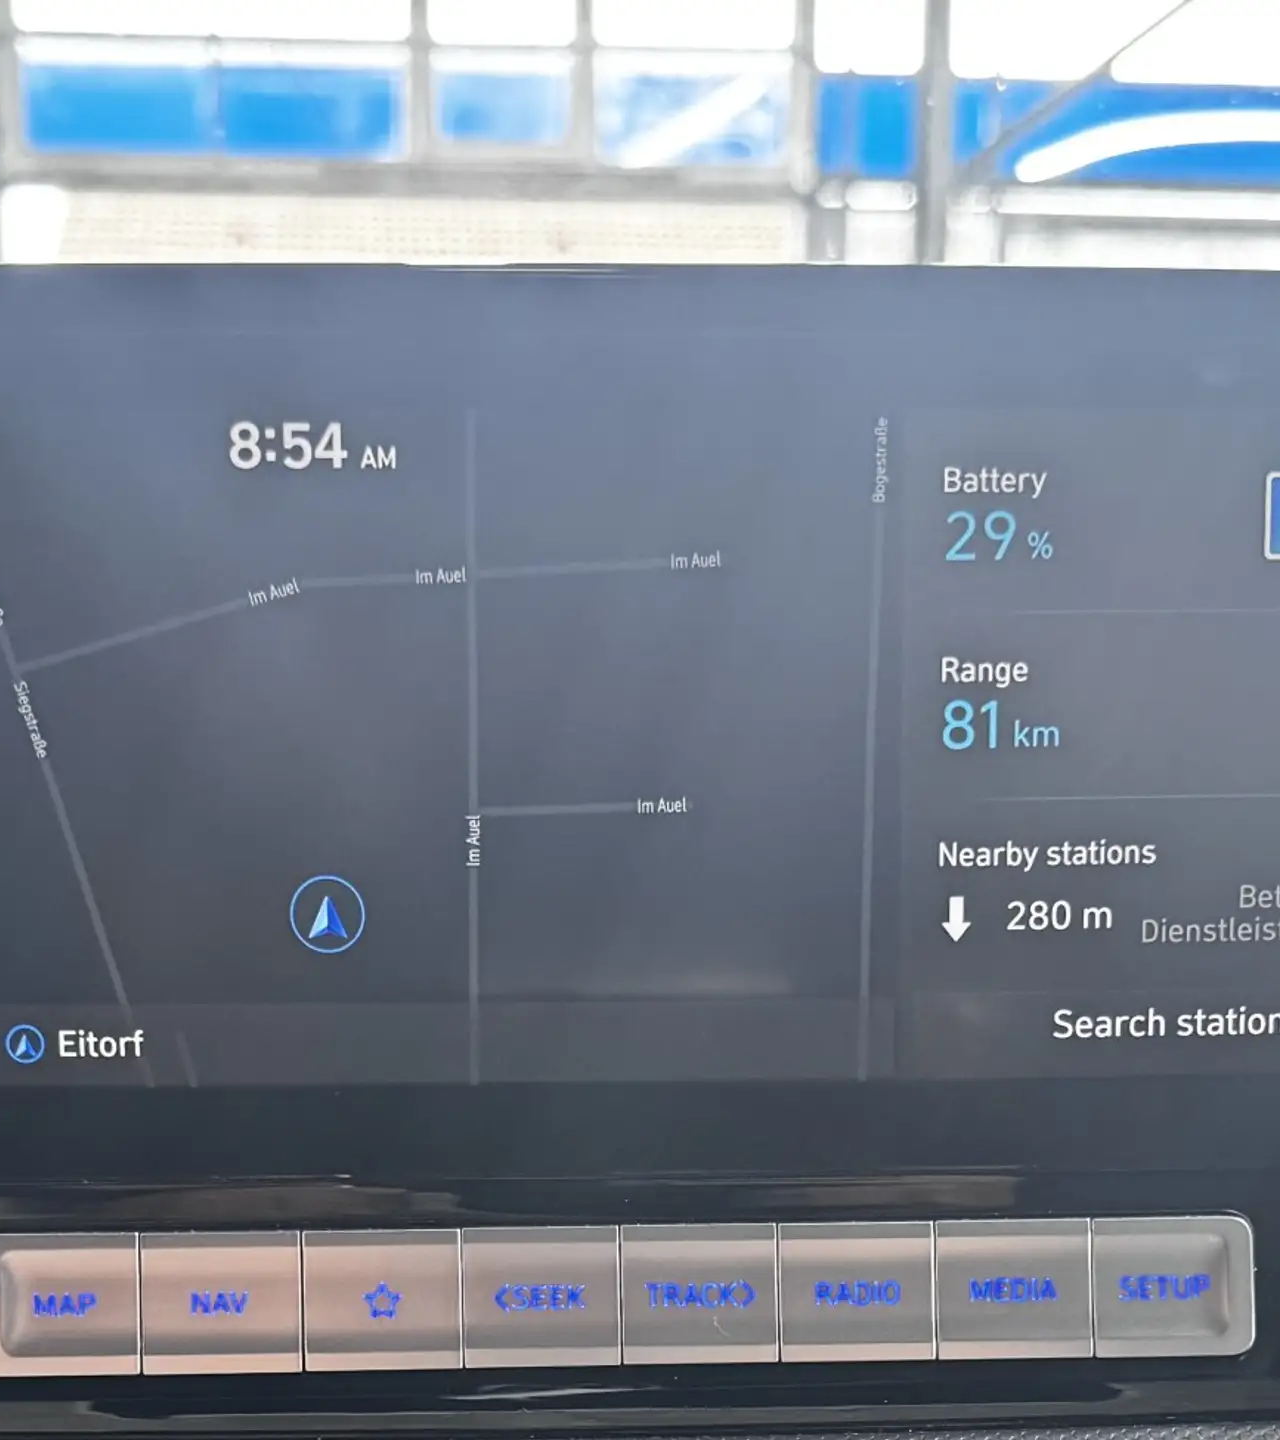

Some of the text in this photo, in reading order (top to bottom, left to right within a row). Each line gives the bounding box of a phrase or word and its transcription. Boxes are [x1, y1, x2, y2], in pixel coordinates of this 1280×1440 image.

[229, 421, 397, 470] 8:54 AM
[943, 466, 1048, 499] Battery
[945, 510, 1054, 561] 29 %
[415, 566, 467, 585] Im Auel
[670, 551, 721, 570] Im Auel
[249, 577, 300, 607] Im Auel
[941, 656, 1030, 688] Range
[14, 680, 47, 759] Siegstraße
[942, 699, 1060, 750] 81 km
[636, 797, 688, 814] Im Auel
[466, 815, 480, 866] Im Auel
[938, 838, 1157, 872] Nearby stations
[1006, 900, 1113, 931] 280 m
[1052, 1007, 1167, 1040] Search
[58, 1030, 145, 1058] Eitorf
[814, 1279, 902, 1307] RADIO
[969, 1275, 1058, 1302] MEDIA
[1118, 1273, 1211, 1301] SETUP
[33, 1291, 98, 1318] MAP
[191, 1290, 250, 1316] NAV
